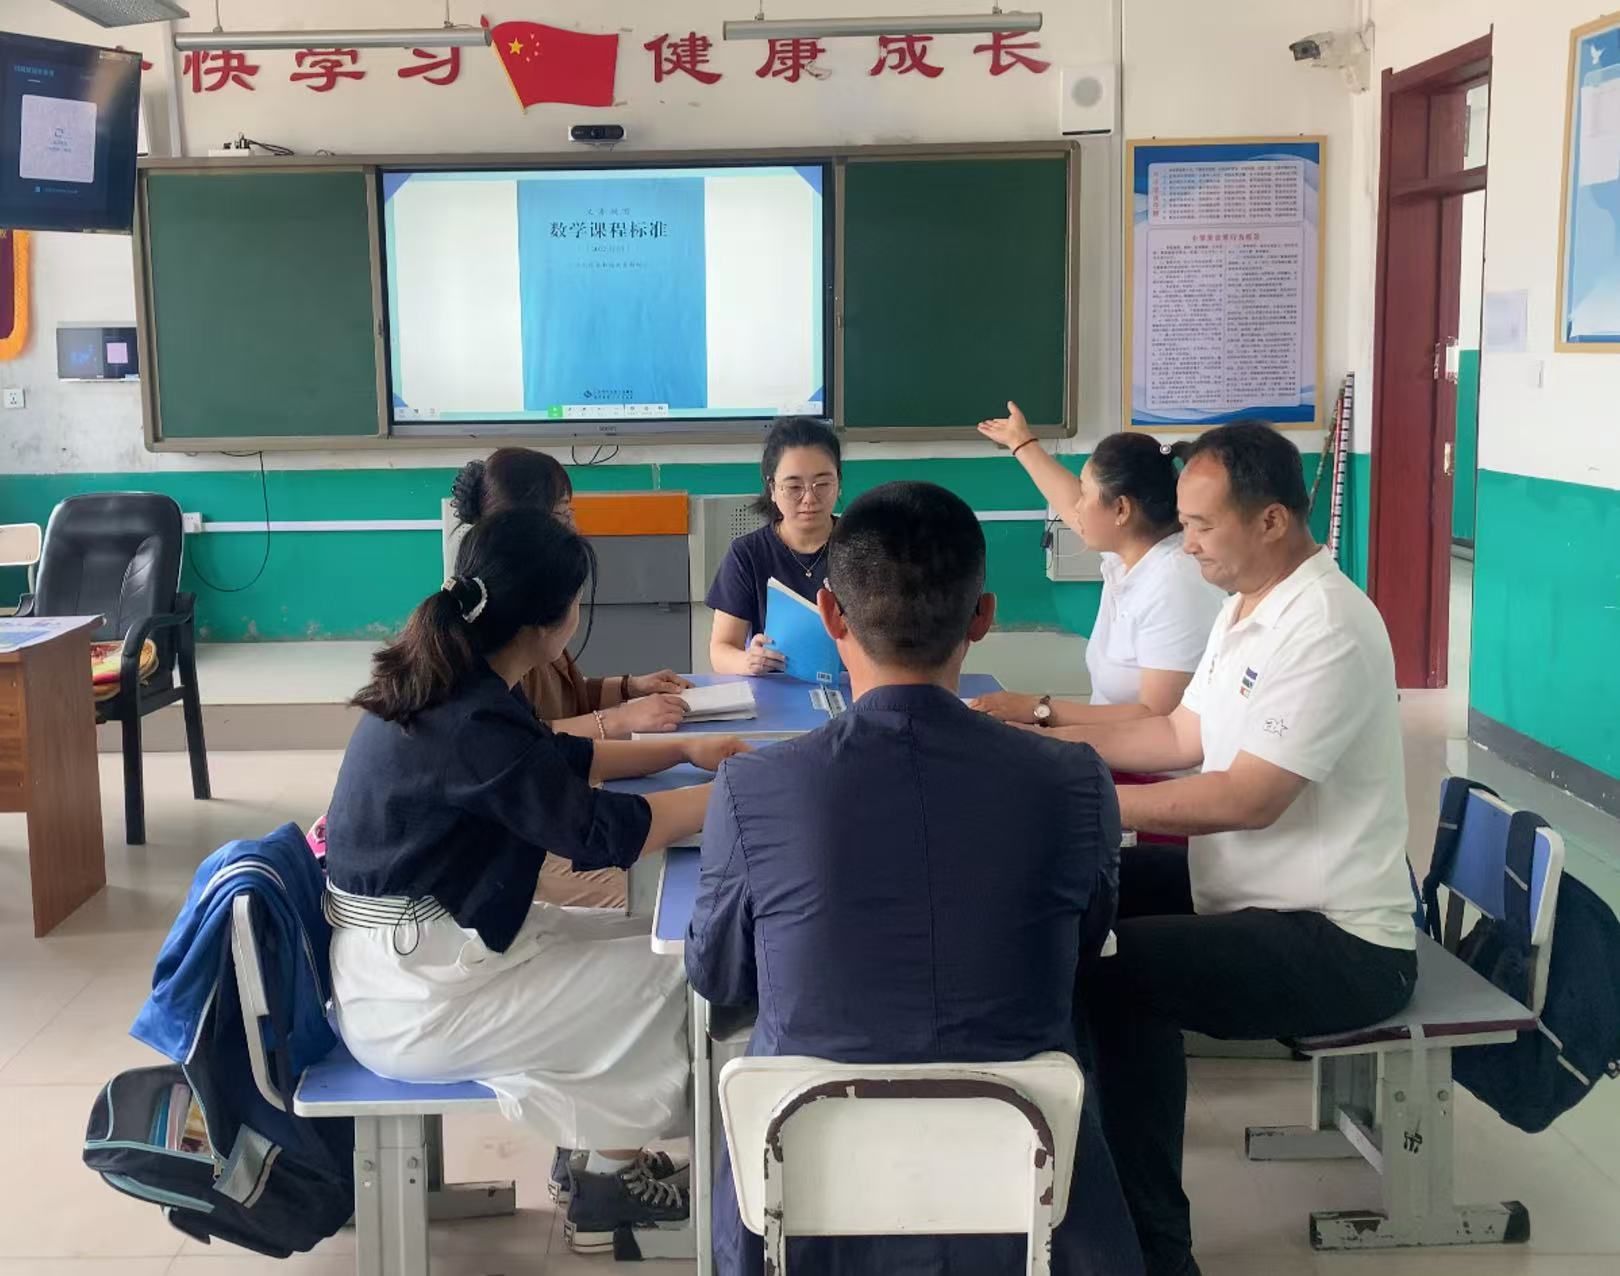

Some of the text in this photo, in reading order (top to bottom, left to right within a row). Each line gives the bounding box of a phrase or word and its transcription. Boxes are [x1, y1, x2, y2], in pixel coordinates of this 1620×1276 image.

[141, 31, 1051, 93] 快学习 健康成长
[550, 220, 668, 239] 数学课程标准
